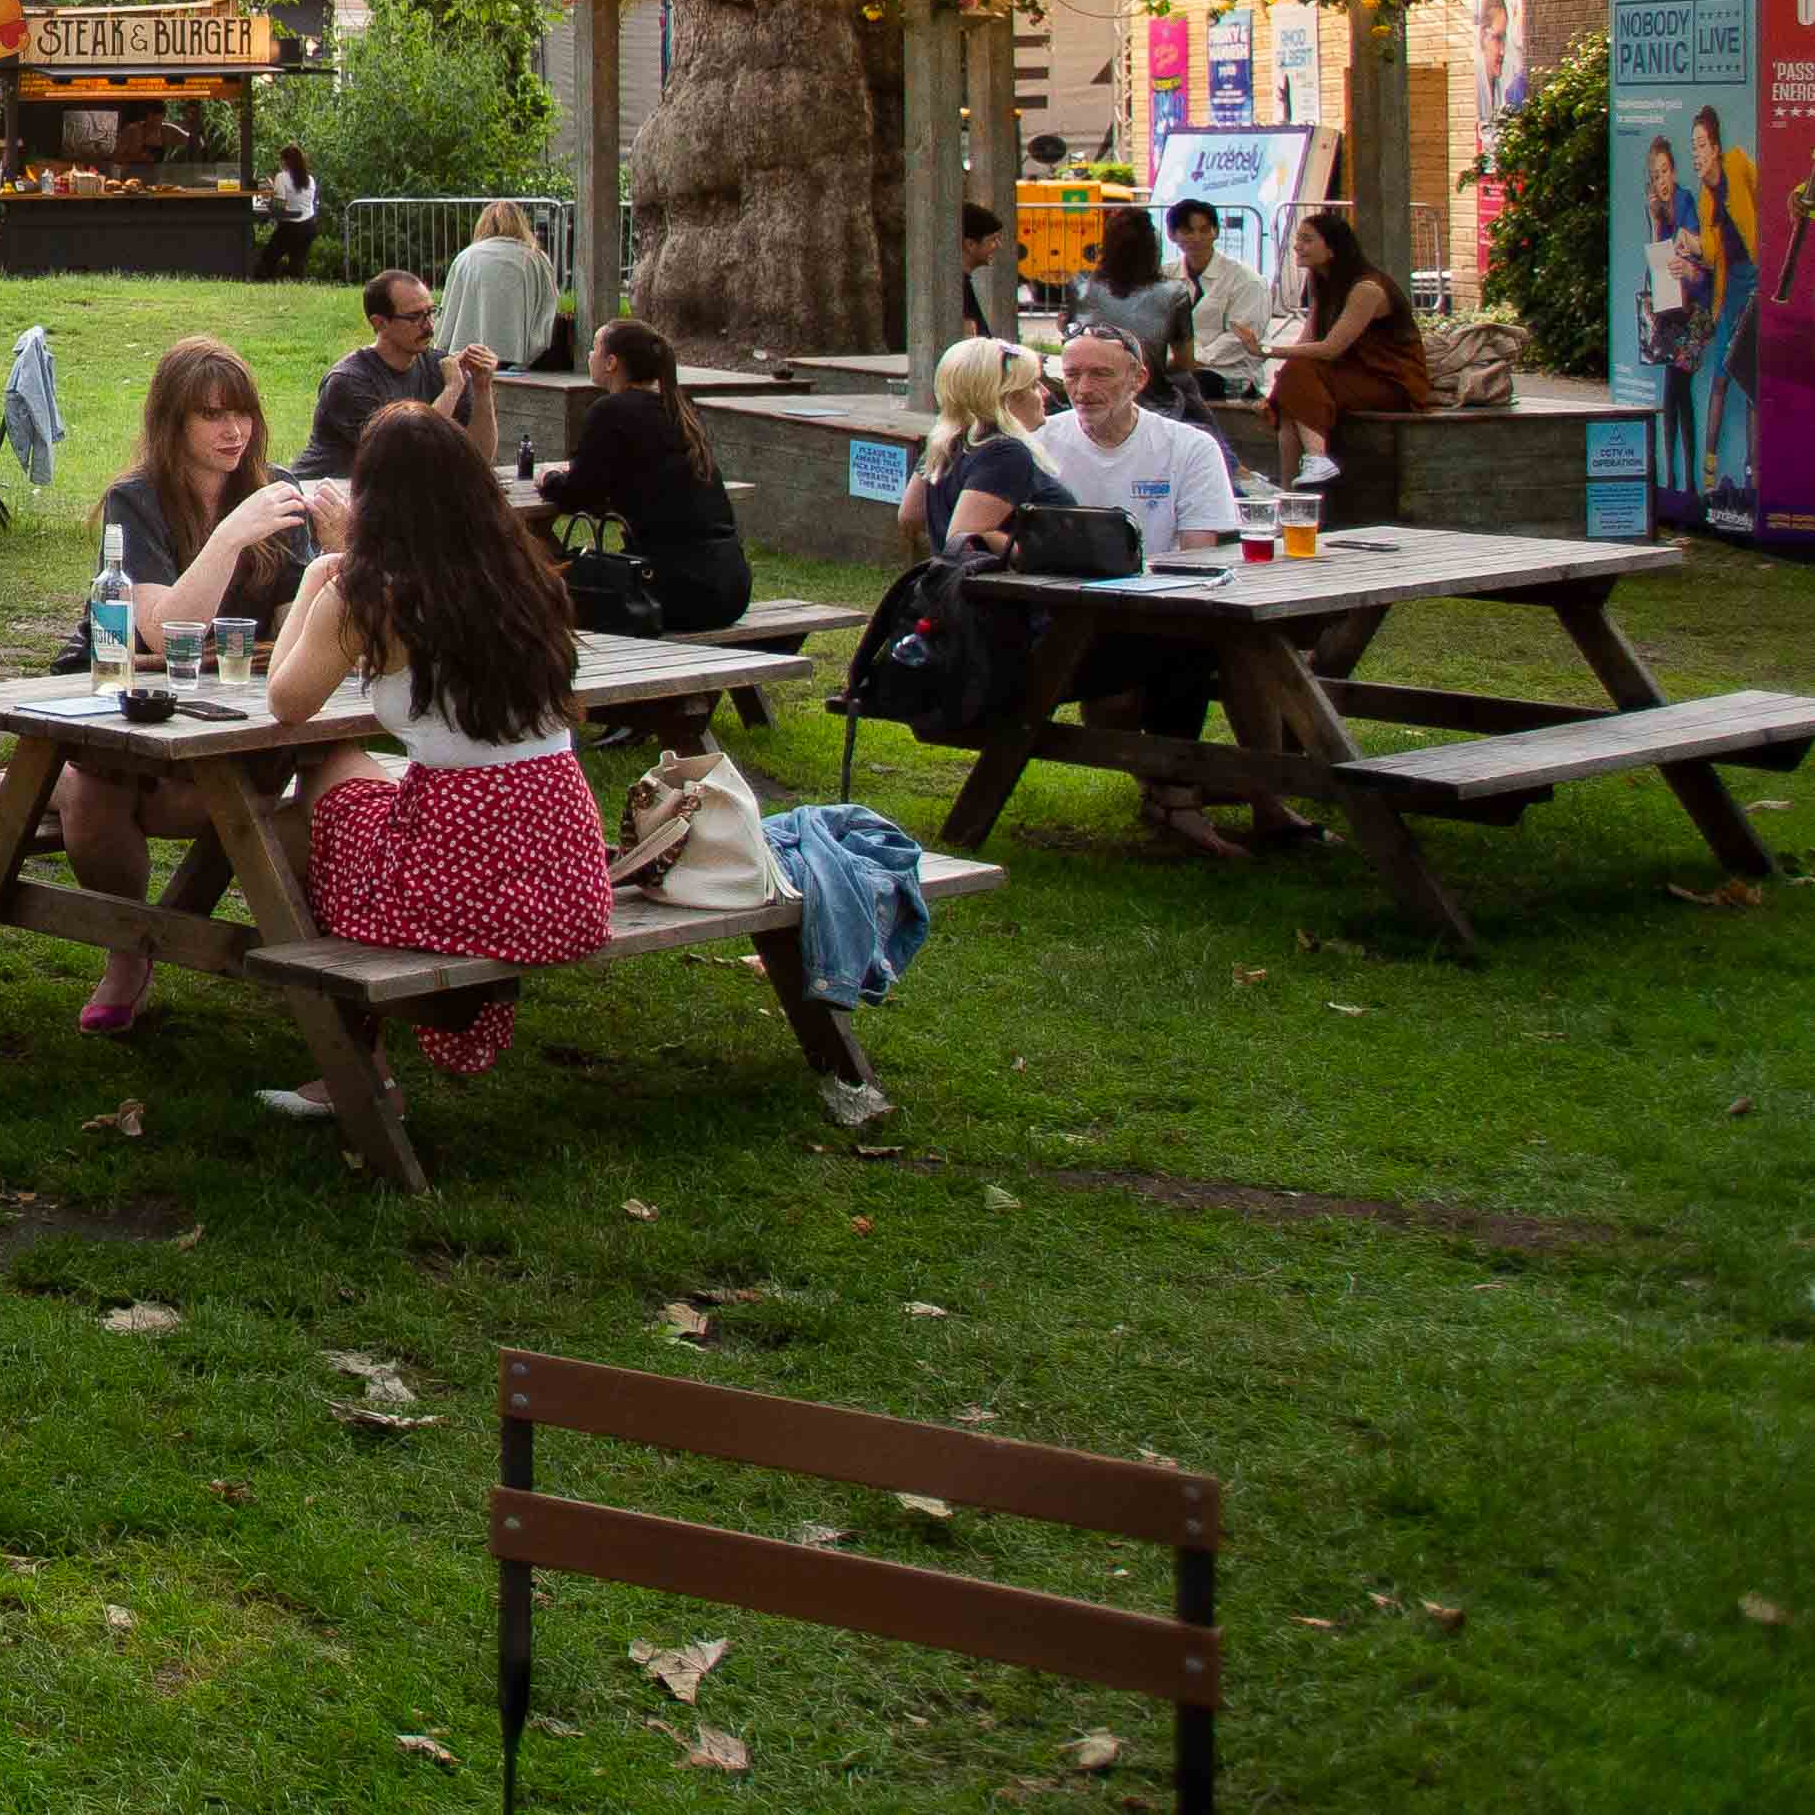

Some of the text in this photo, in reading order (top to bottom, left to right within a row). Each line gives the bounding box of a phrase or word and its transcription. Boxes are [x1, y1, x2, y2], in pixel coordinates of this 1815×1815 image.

[1620, 9, 1690, 37] NOBODY
[36, 19, 252, 56] STEAK & BURGER
[1699, 27, 1740, 54] LIVE
[1620, 41, 1688, 74] PANIC
[1592, 458, 1642, 467] OPERATION
[1600, 448, 1634, 458] CCTV IN
